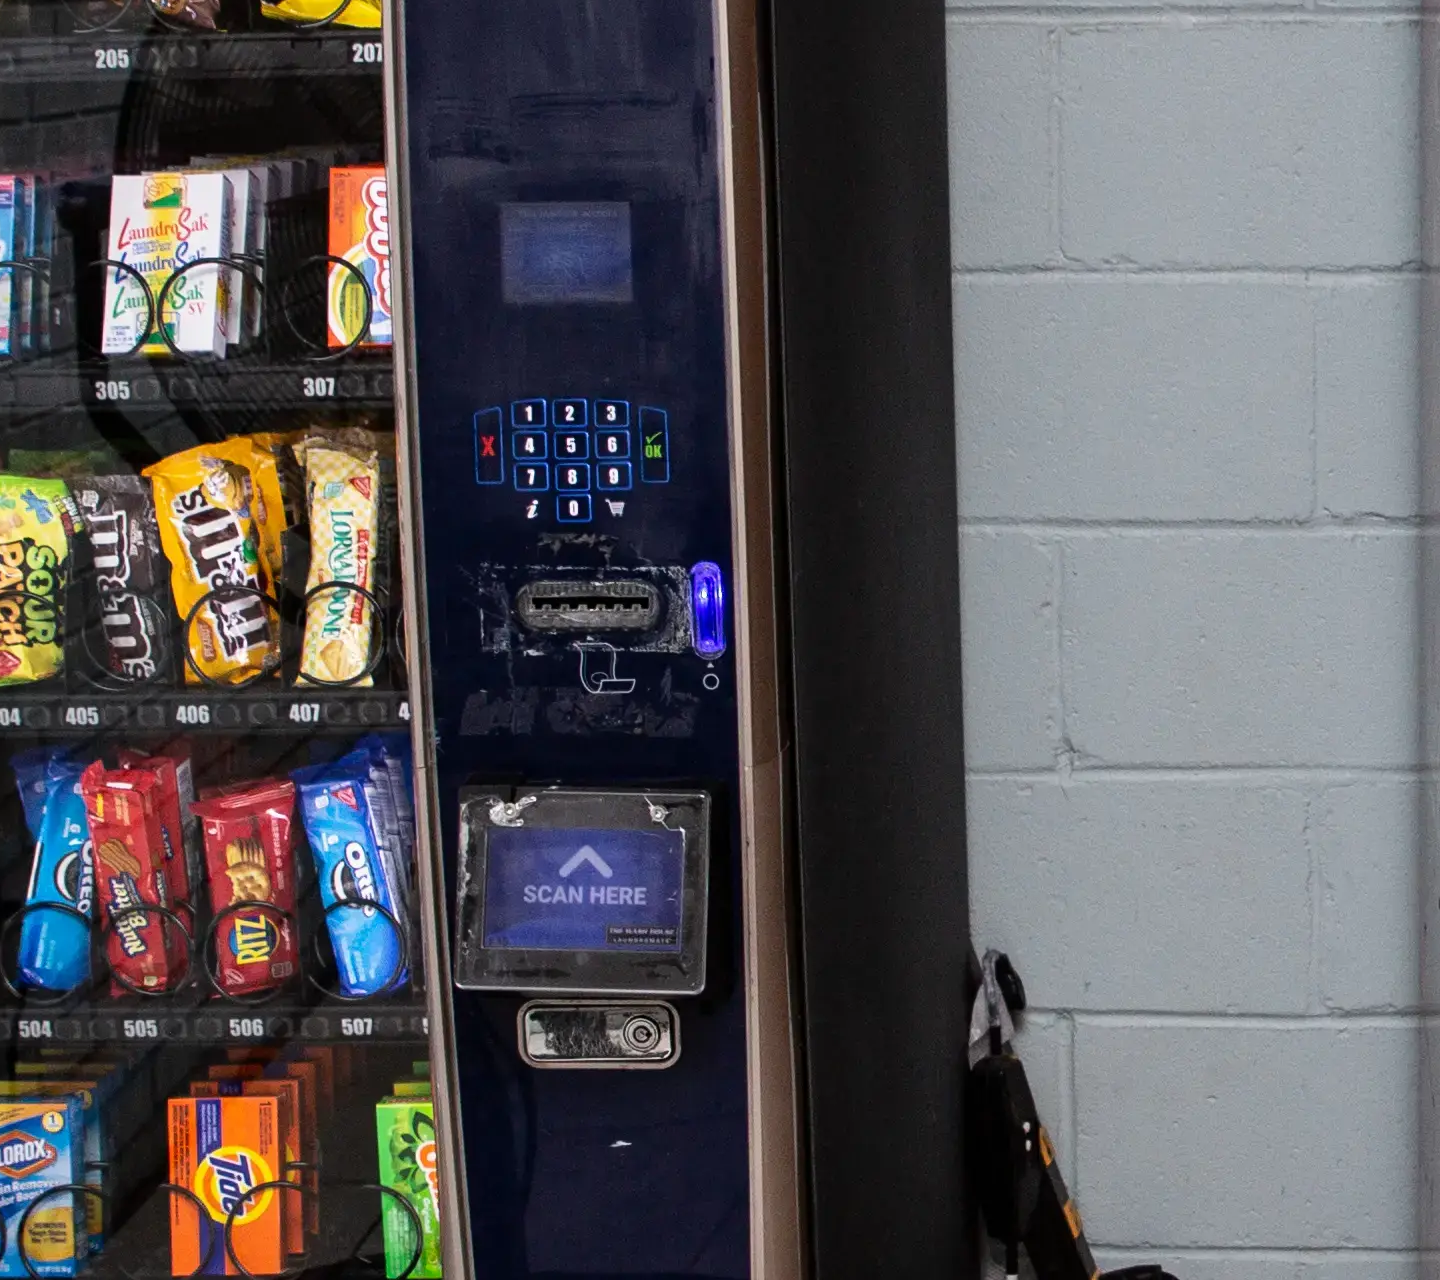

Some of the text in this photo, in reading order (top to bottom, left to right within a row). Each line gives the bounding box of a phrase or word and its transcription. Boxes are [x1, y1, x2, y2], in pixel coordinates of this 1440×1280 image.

[95, 49, 129, 69] 205
[352, 43, 383, 63] 207
[95, 381, 130, 401] 305
[303, 377, 335, 397] 307
[525, 405, 616, 421] 1 2 3
[525, 437, 617, 453] 4 5 6
[645, 444, 662, 459] OK
[526, 468, 619, 485] 7 8 9
[569, 500, 579, 516] 0
[24, 544, 57, 643] SOUR
[65, 706, 99, 725] 405
[176, 704, 210, 724] 406
[289, 703, 321, 723] 407
[345, 840, 375, 918] OREO
[523, 884, 648, 906] SCAN HERE
[108, 905, 147, 956] Nuttr
[234, 914, 271, 966] RITZ
[19, 1020, 53, 1038] 504
[124, 1020, 158, 1038] 505
[229, 1019, 264, 1038] 506
[342, 1018, 373, 1036] 507
[208, 1152, 254, 1217] Tide
